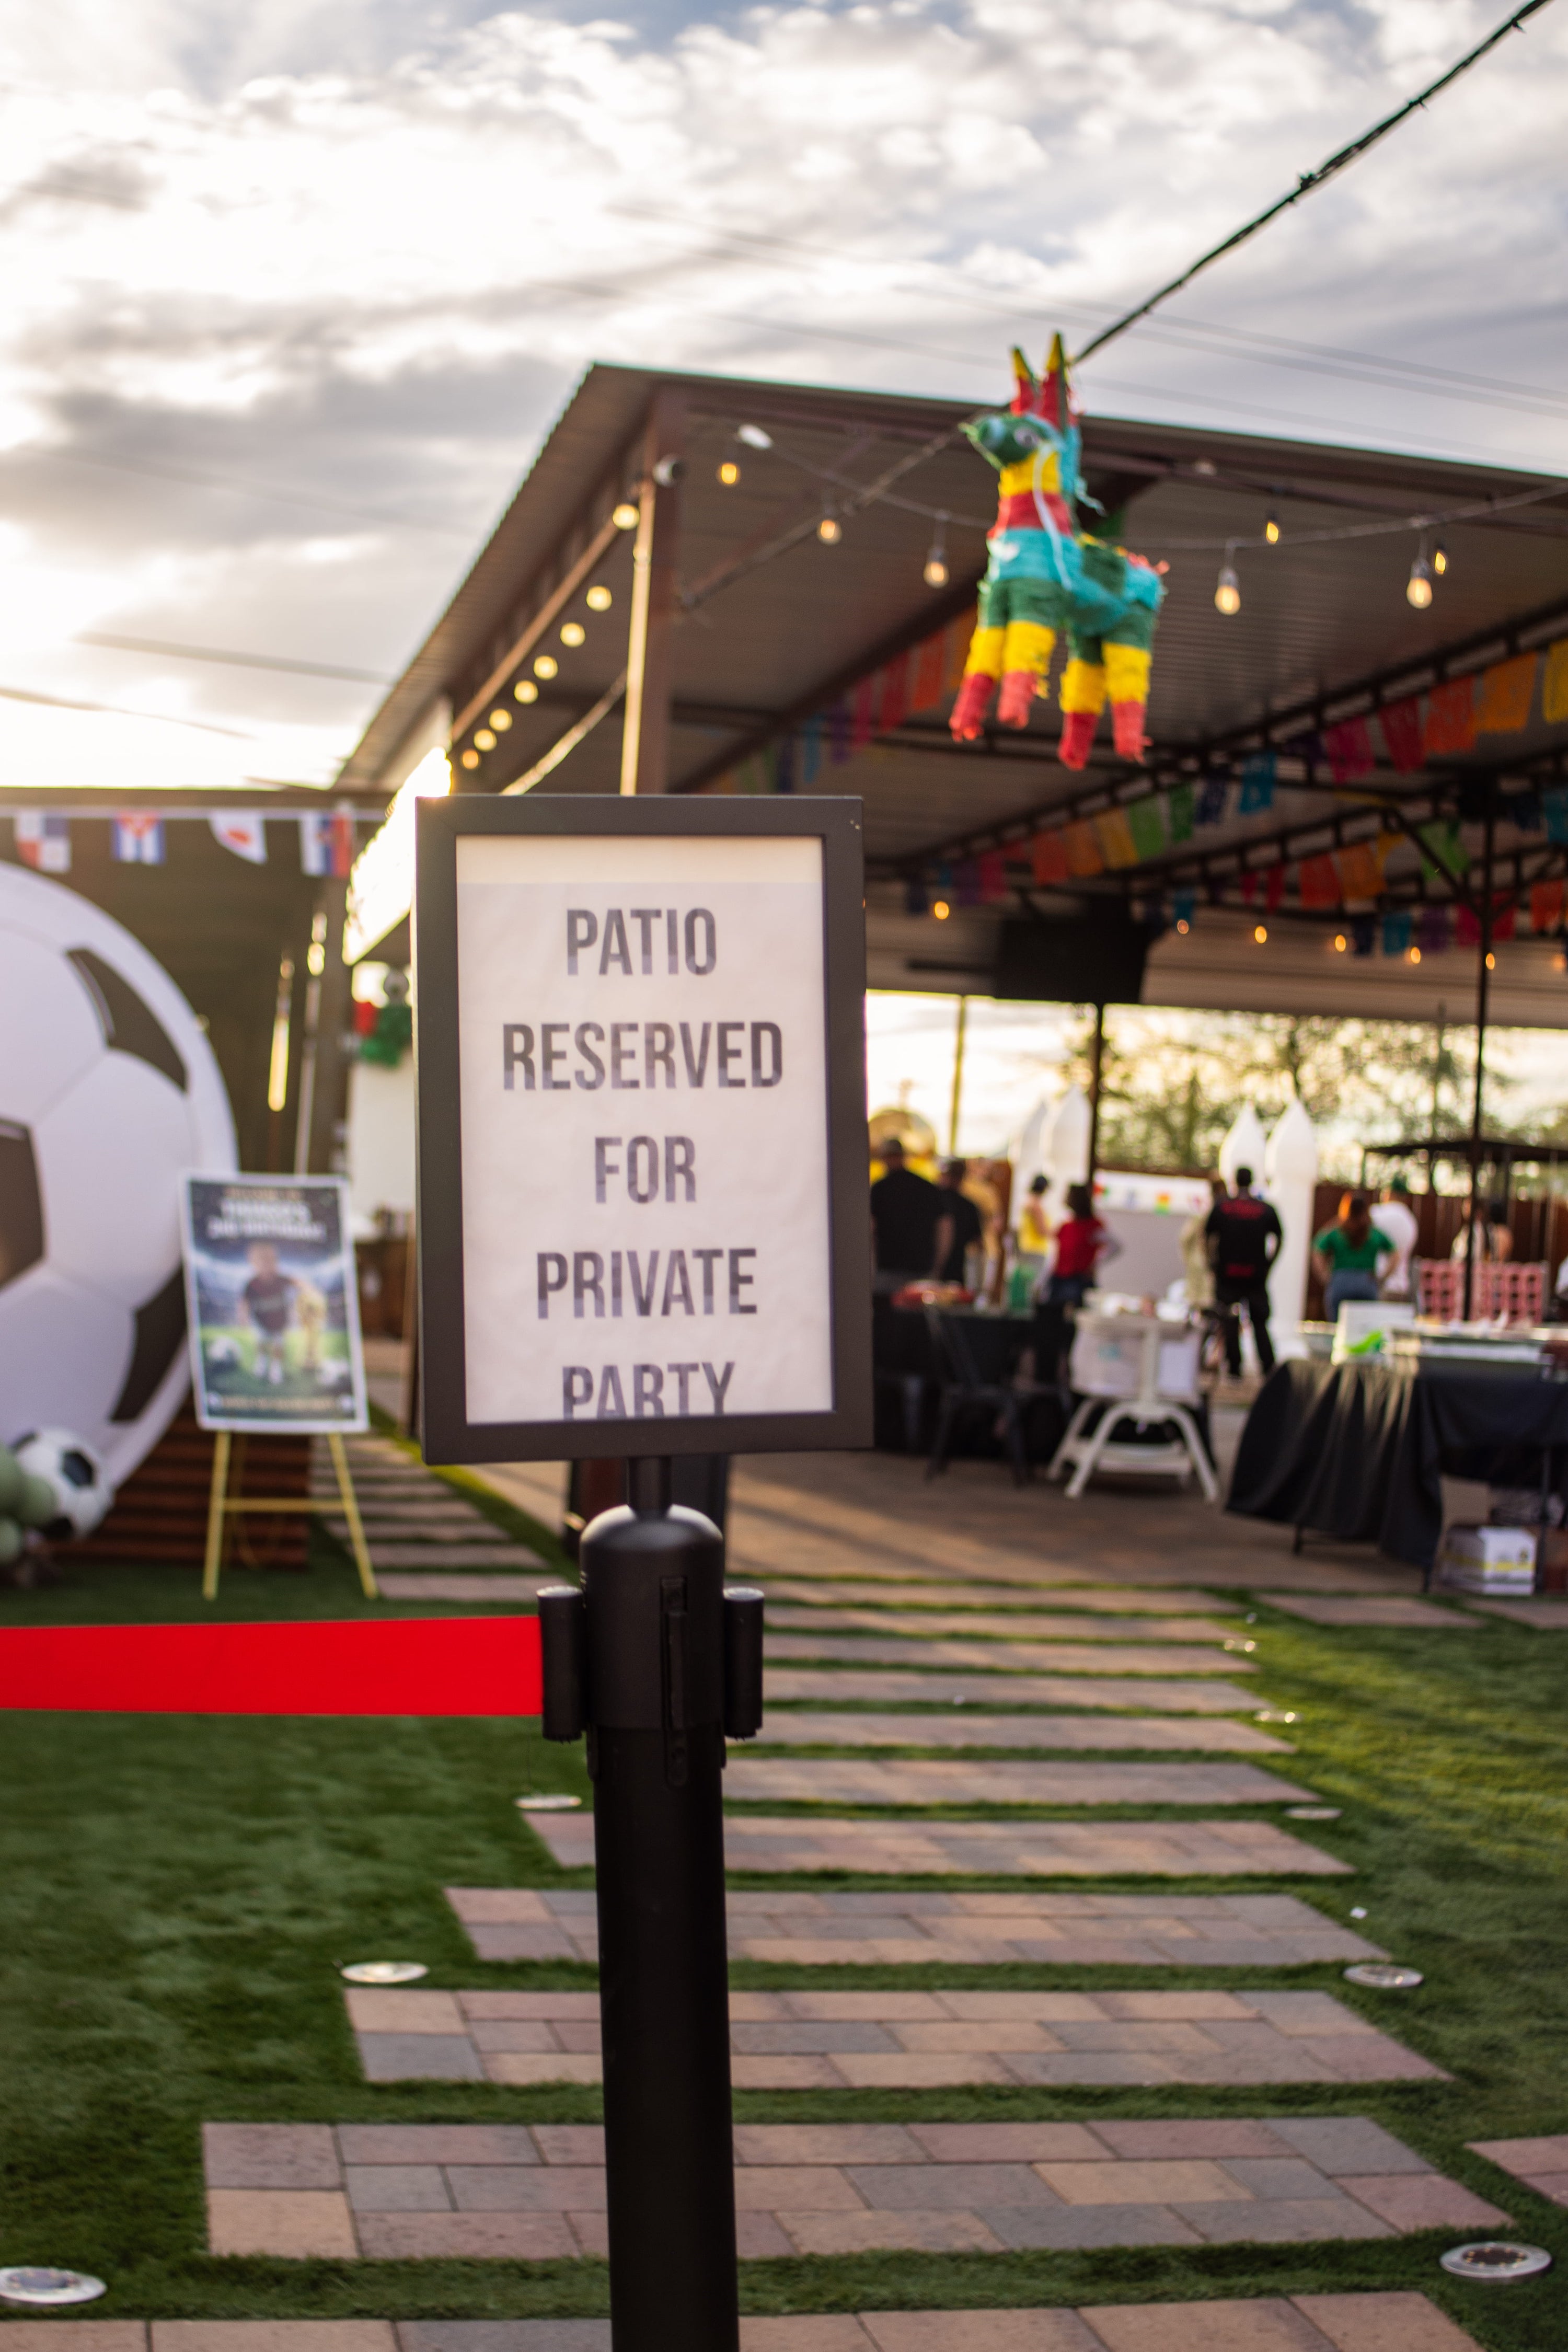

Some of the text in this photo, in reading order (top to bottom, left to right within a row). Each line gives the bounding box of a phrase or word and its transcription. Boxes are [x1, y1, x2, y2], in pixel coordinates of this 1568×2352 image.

[566, 907, 718, 977] PATIO
[502, 1020, 783, 1091] RESERVED
[594, 1134, 697, 1205] FOR
[536, 1247, 758, 1320] PRIVATE
[562, 1361, 735, 1420] PARTY
